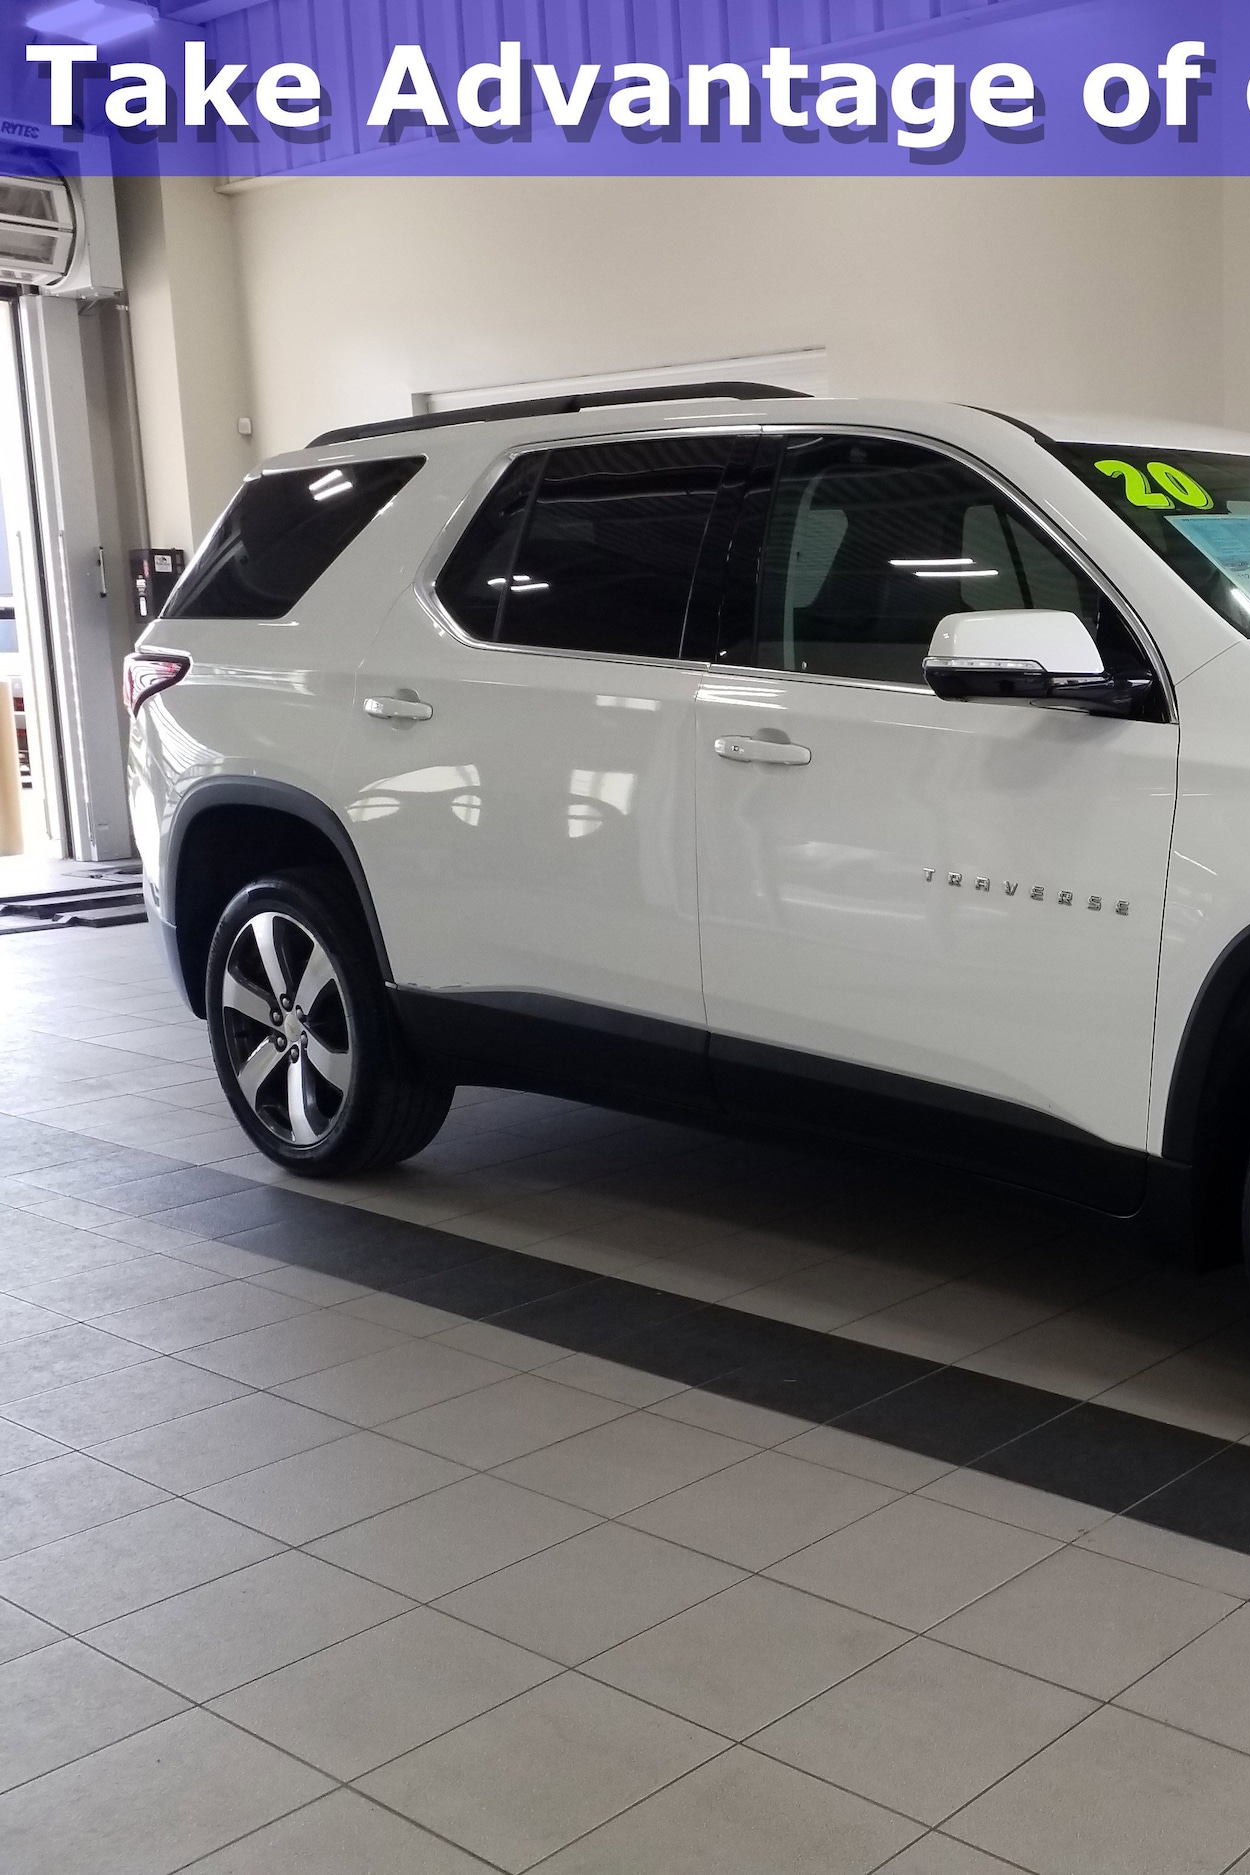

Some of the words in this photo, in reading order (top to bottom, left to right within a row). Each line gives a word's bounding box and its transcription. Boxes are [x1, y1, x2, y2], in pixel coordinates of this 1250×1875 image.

[1, 121, 40, 139] RYTEC
[1094, 460, 1214, 510] 20
[923, 867, 1130, 916] TRAVERSE
